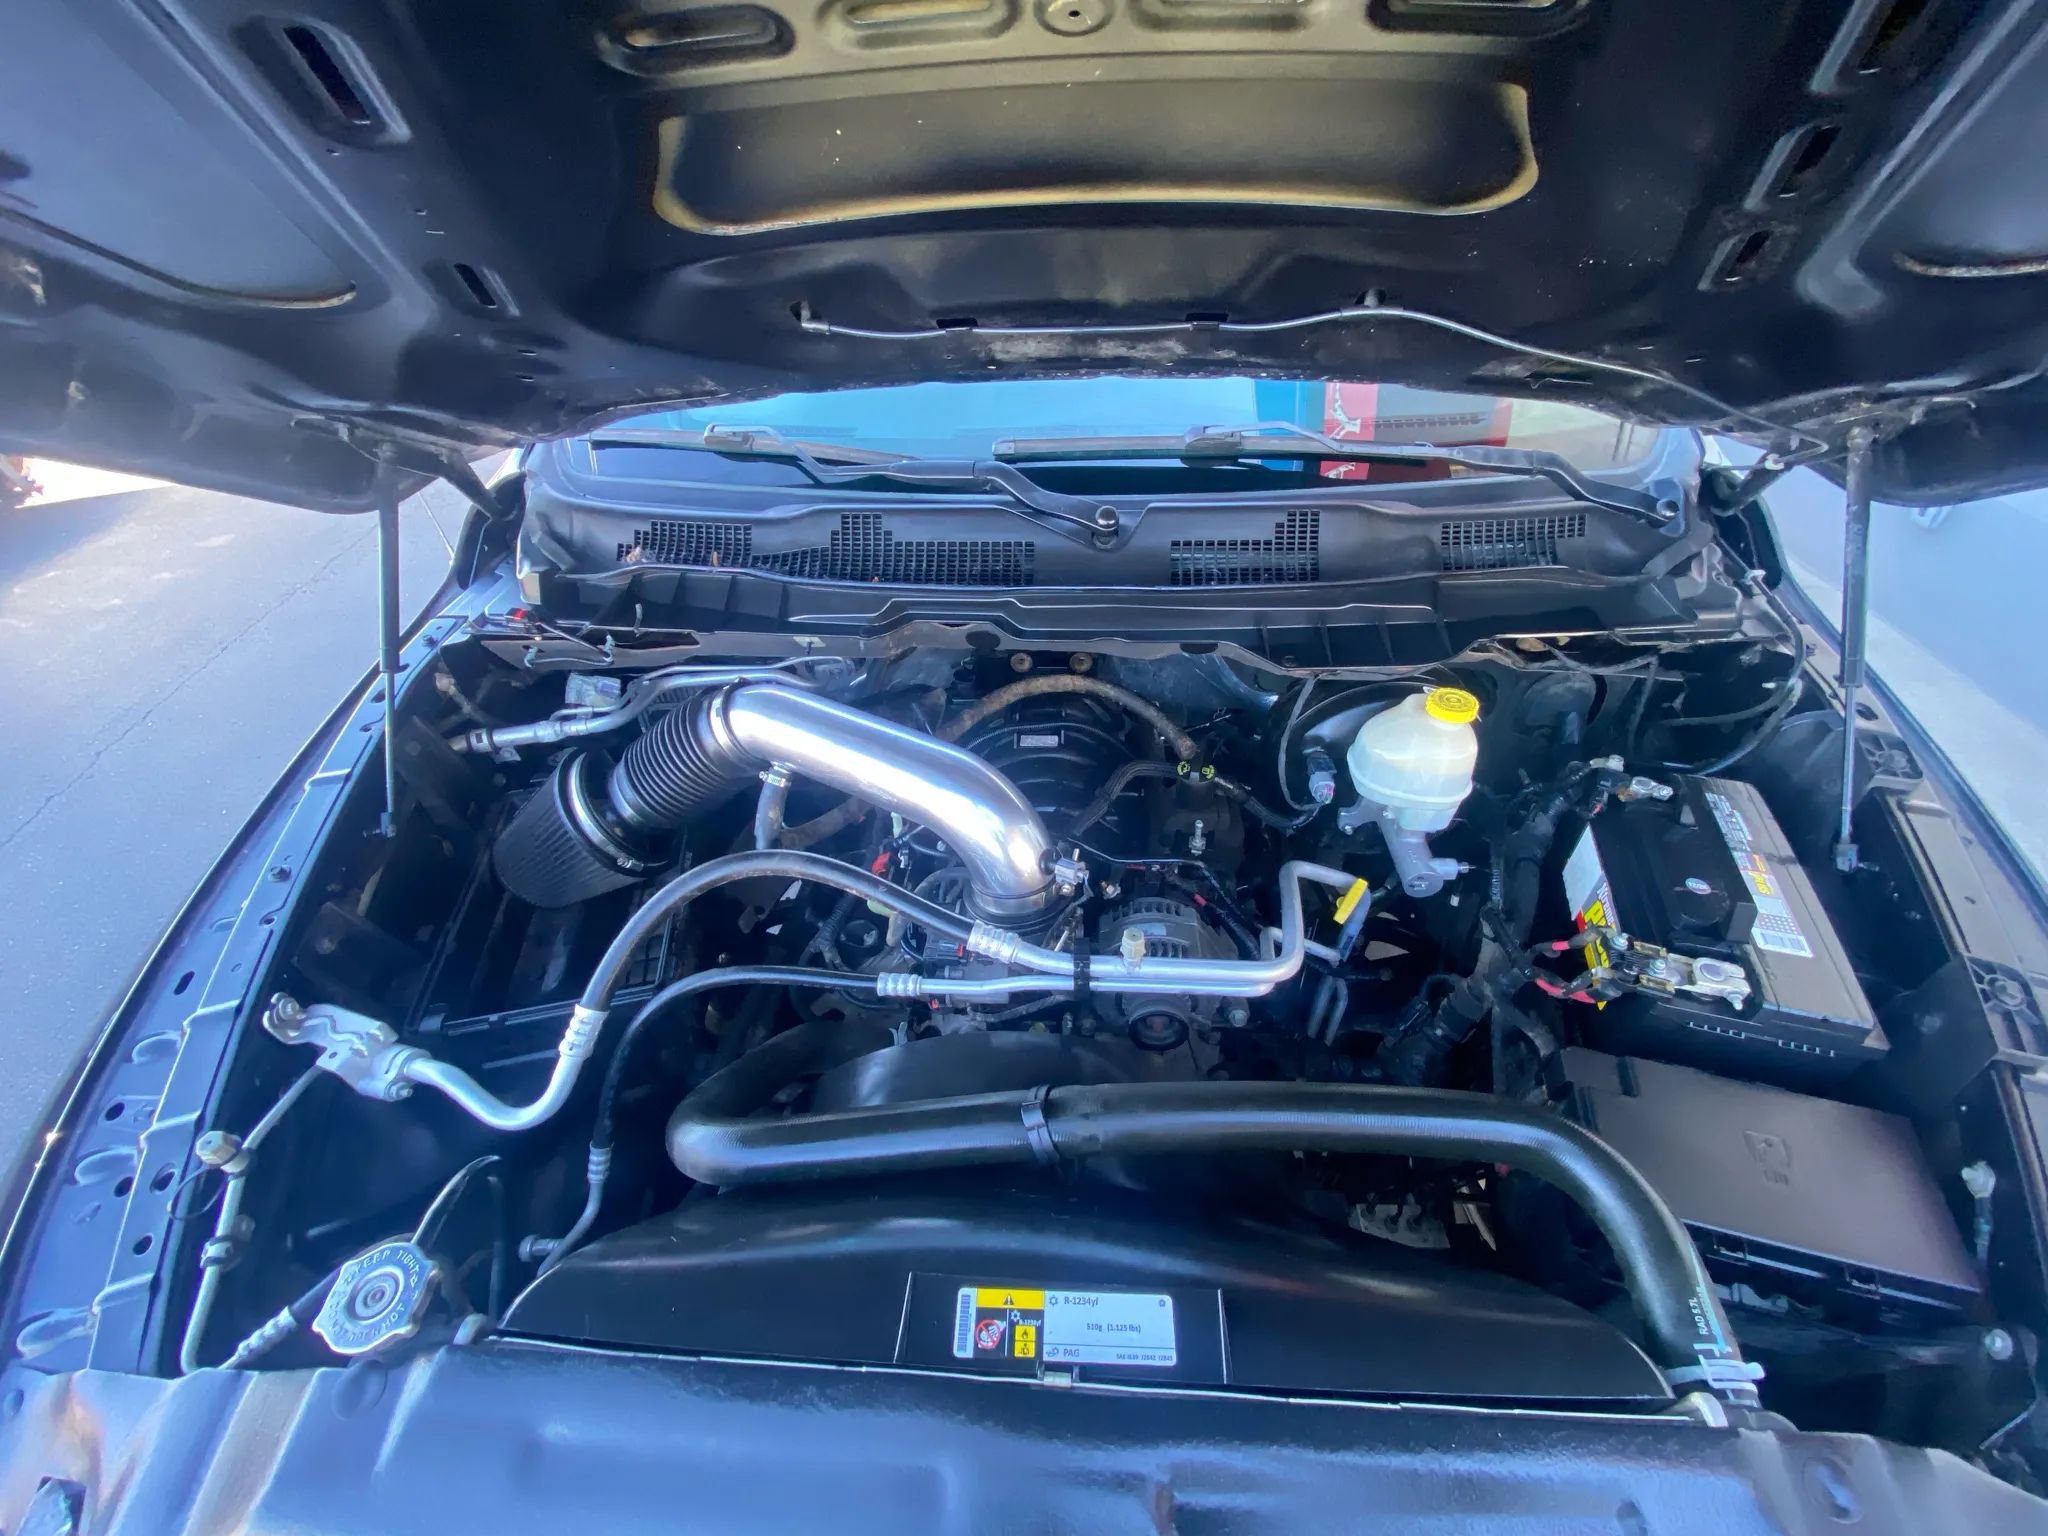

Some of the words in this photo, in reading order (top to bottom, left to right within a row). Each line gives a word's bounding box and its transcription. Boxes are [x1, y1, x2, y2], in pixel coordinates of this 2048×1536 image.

[397, 1250, 420, 1274] TIGHT
[1064, 1296, 1099, 1307] R-1234yf
[382, 1303, 405, 1329] HOT
[1695, 1315, 1709, 1334] RAD
[1063, 1348, 1080, 1358] PAG
